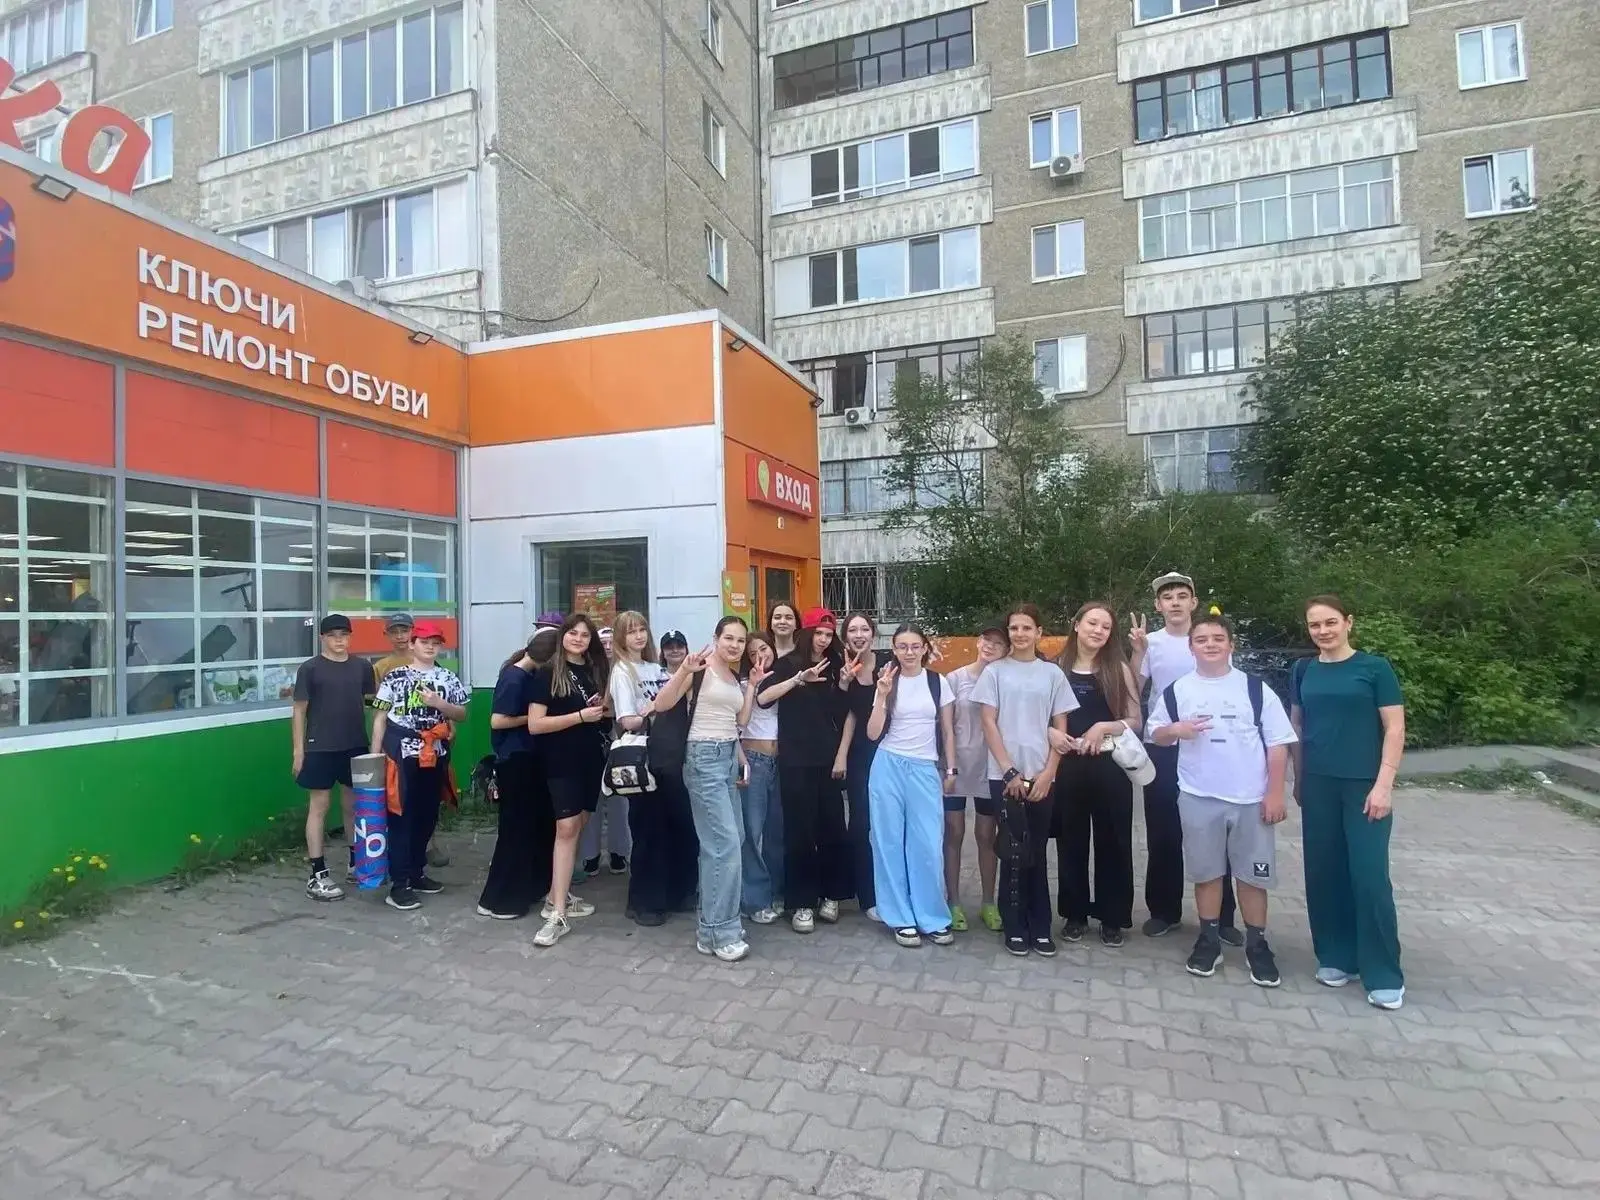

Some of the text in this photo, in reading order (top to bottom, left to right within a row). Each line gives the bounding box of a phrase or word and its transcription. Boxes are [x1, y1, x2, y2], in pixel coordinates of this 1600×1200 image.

[138, 247, 295, 334] КЛЮЧИ
[138, 301, 428, 419] РЕМОНТ ОБУВИ
[775, 471, 812, 513] ВХОД
